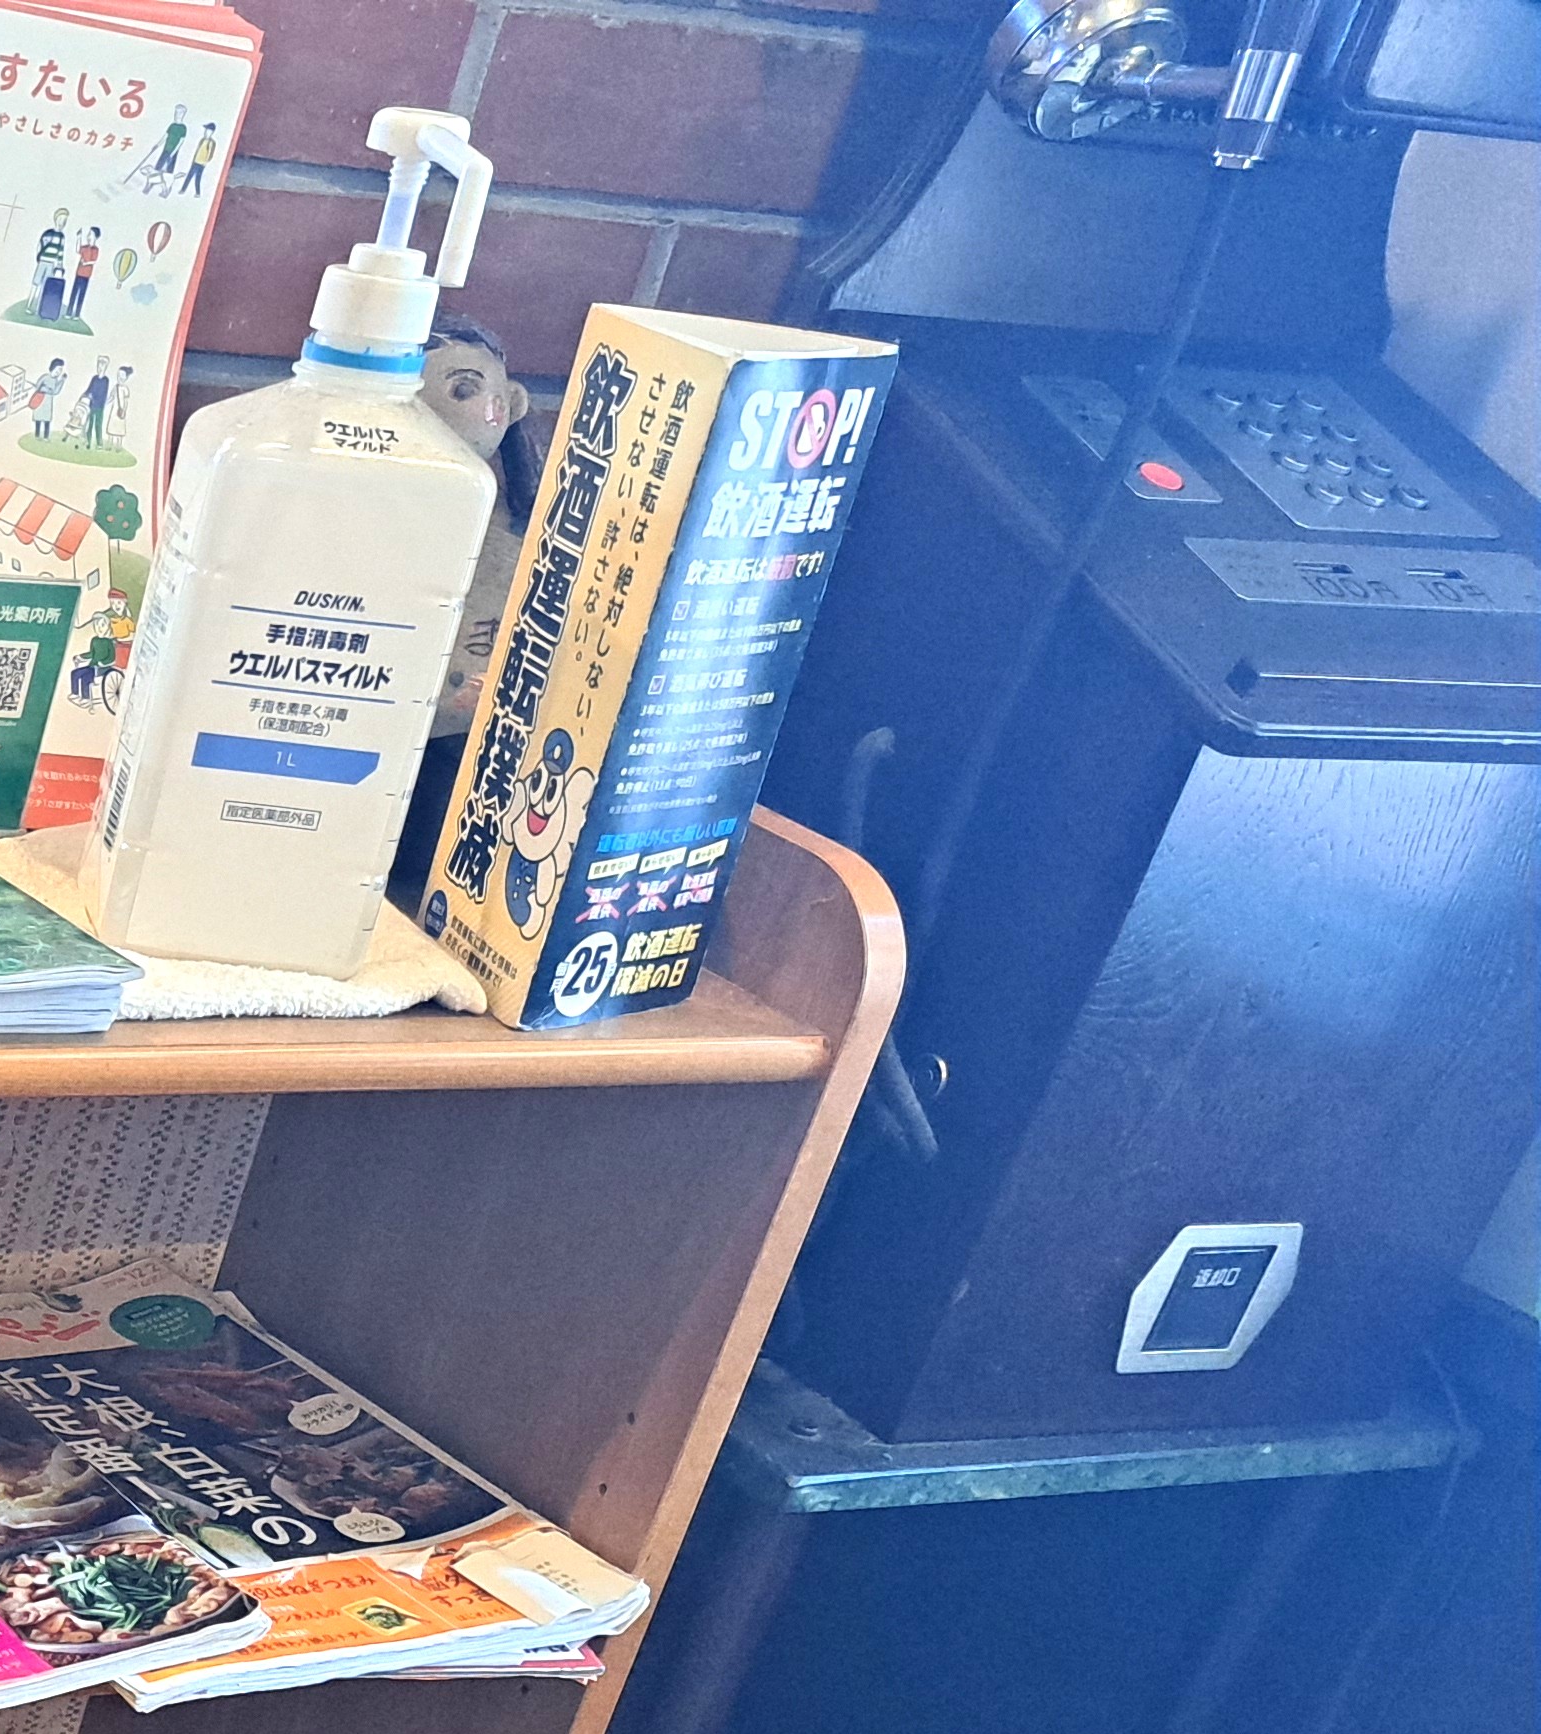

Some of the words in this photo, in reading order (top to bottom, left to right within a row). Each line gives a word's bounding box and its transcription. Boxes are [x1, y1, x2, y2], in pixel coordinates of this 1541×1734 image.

[324, 420, 400, 444] ウエルパス
[332, 437, 393, 456] マイルド
[702, 476, 847, 539] 飲酒運転
[294, 590, 363, 612] DUSKIN
[265, 623, 370, 655] 手指消毒剤
[229, 651, 395, 693] ウエルパスマイルド
[248, 697, 348, 724] 手指を素早く消毒
[622, 924, 702, 963] 飲酒運転
[41, 1363, 317, 1548] 大根、白菜の
